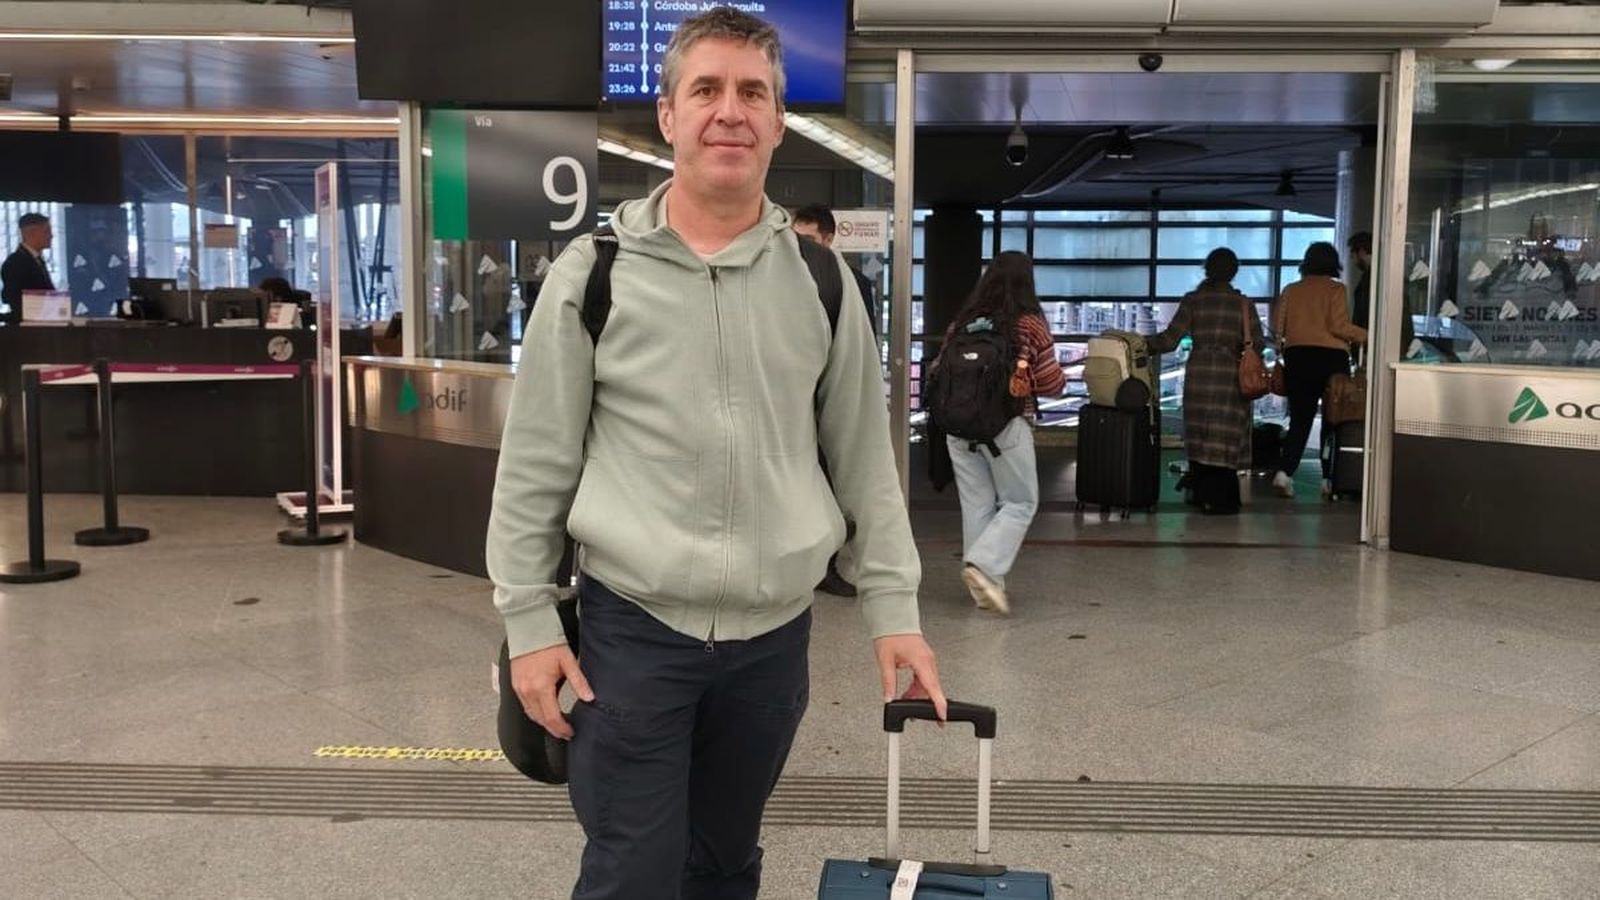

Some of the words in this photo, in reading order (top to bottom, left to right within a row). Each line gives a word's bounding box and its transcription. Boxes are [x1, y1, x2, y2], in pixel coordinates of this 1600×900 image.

[654, 1, 697, 11] Córdoba
[608, 84, 636, 94] 23:26
[543, 156, 587, 231] 9
